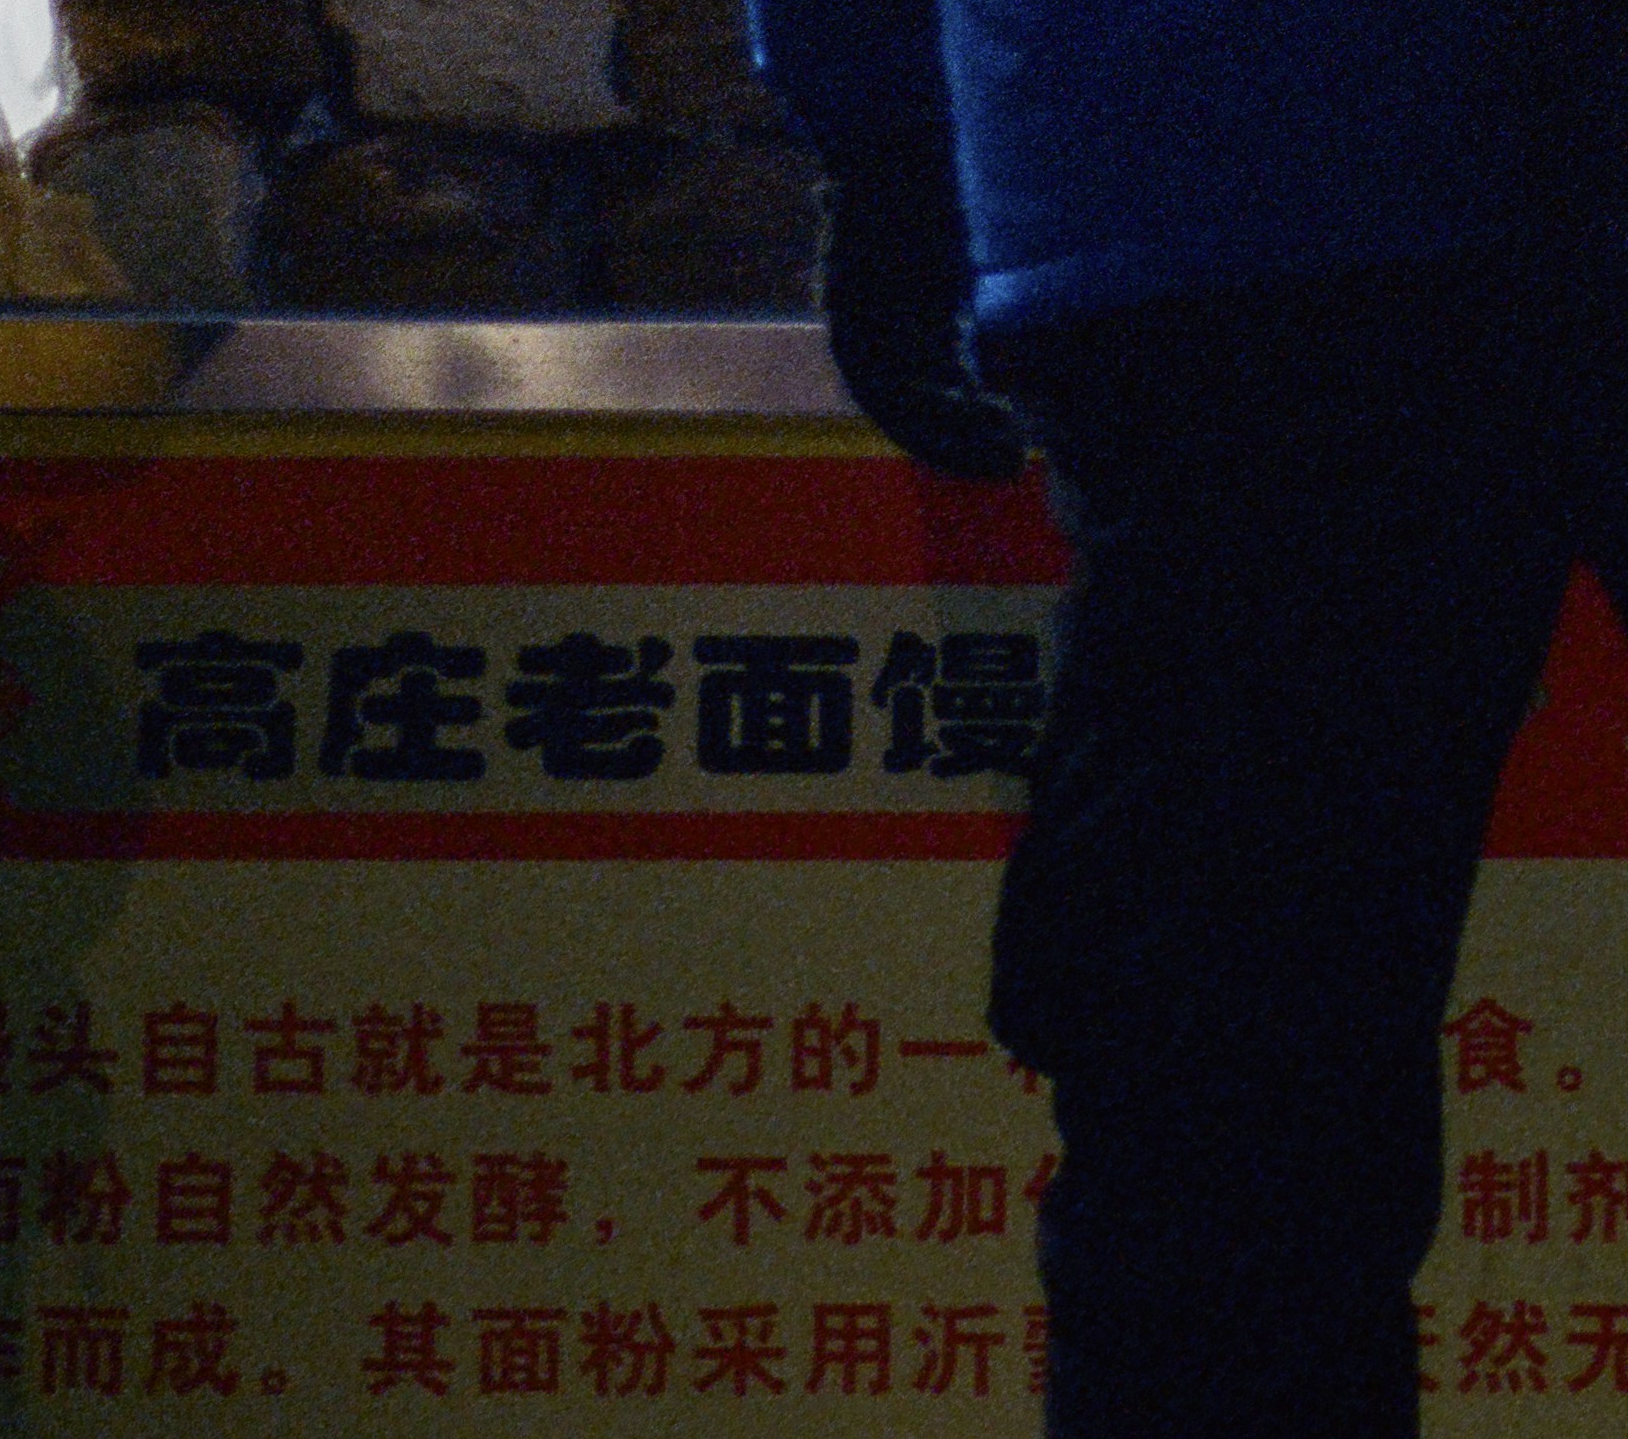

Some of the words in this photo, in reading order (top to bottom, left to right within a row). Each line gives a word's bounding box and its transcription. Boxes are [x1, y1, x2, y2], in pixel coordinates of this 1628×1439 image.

[134, 629, 1044, 783] 高庄老面馒
